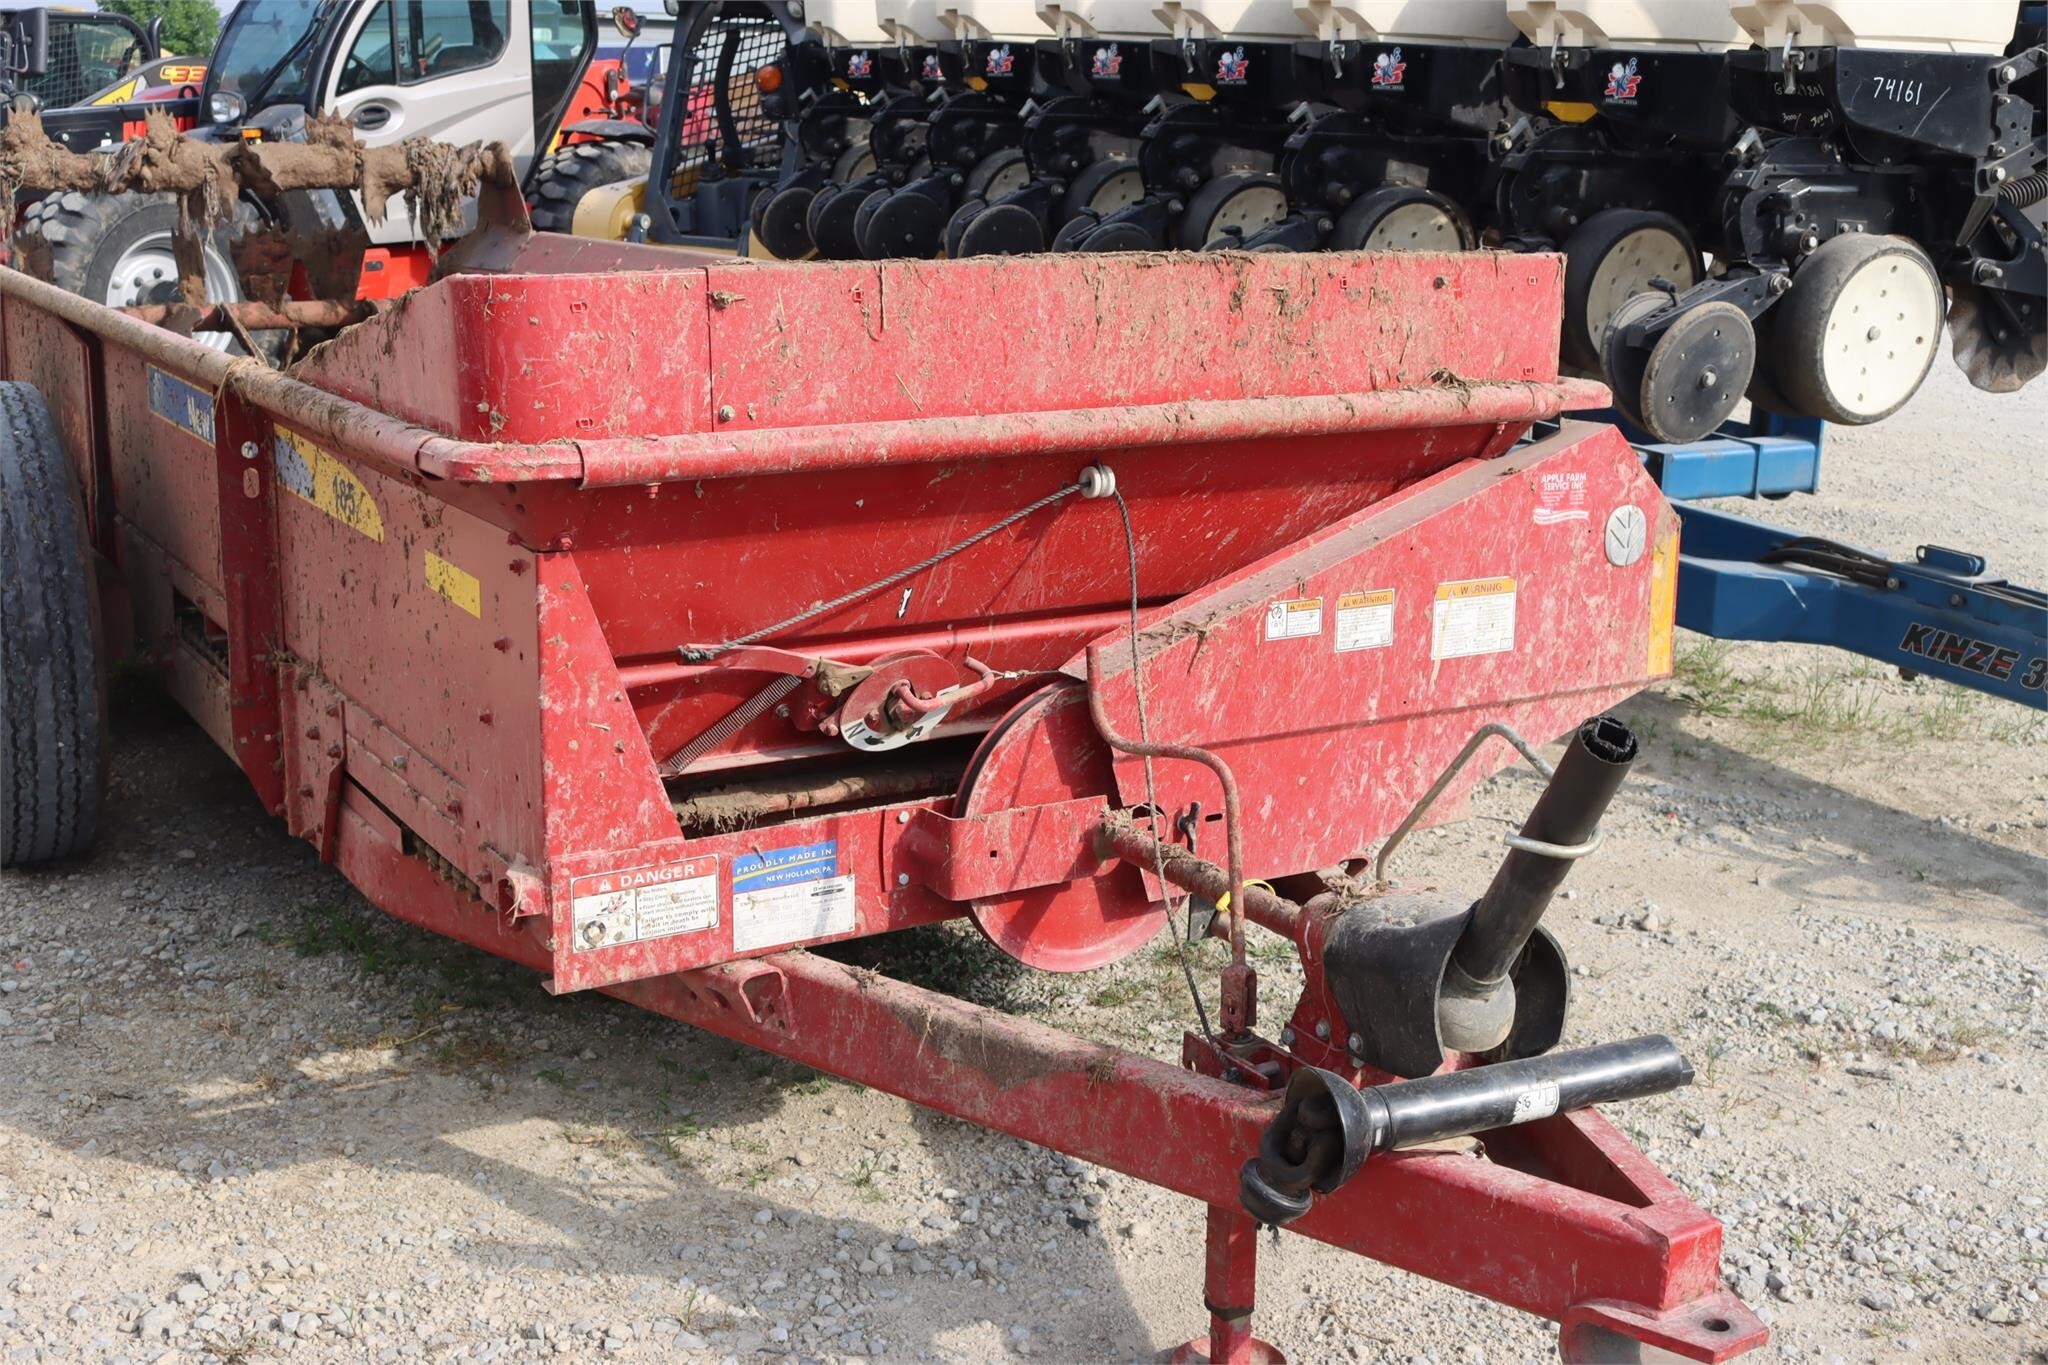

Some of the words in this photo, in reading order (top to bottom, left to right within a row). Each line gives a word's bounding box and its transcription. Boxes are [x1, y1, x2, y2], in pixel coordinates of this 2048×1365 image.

[1873, 76, 1923, 105] 74161
[186, 394, 211, 441] New
[1541, 474, 1565, 483] APPLE
[1566, 472, 1587, 482] FARM
[1543, 482, 1569, 491] SERVICE
[332, 474, 355, 516] 185
[1899, 622, 2022, 682] KINZE
[2020, 657, 2048, 693] 3
[620, 864, 695, 888] DANGER
[736, 857, 785, 876] PROUDLY
[788, 851, 818, 863] MADE
[821, 848, 833, 857] IN
[766, 875, 784, 883] NEW
